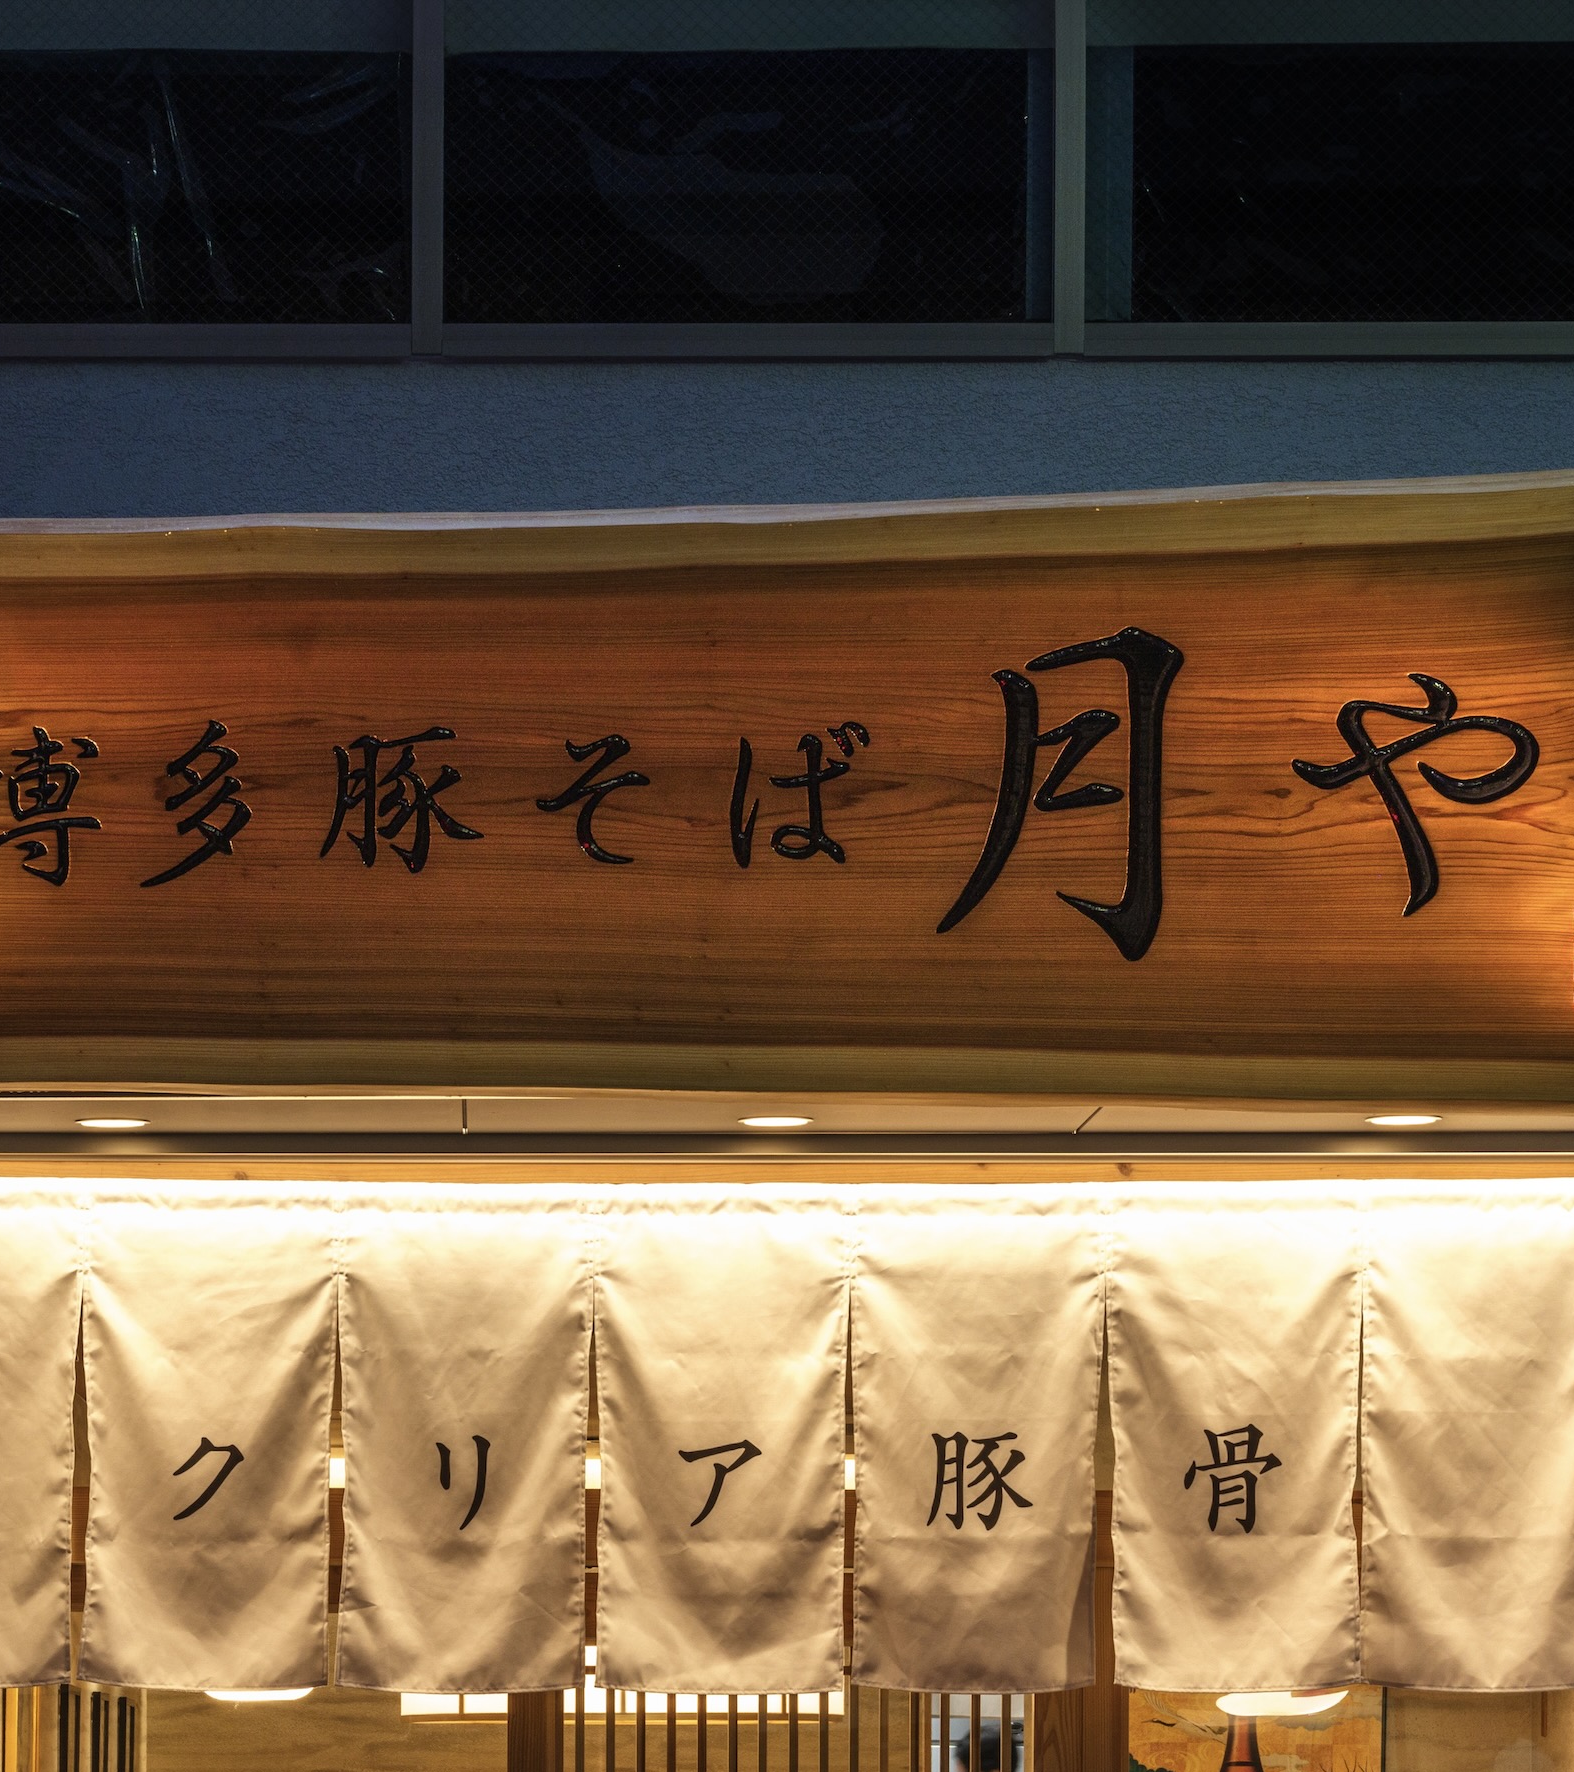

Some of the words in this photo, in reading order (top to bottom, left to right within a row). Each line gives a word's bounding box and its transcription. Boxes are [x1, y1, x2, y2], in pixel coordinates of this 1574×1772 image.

[171, 1423, 1283, 1535] クリア豚骨
